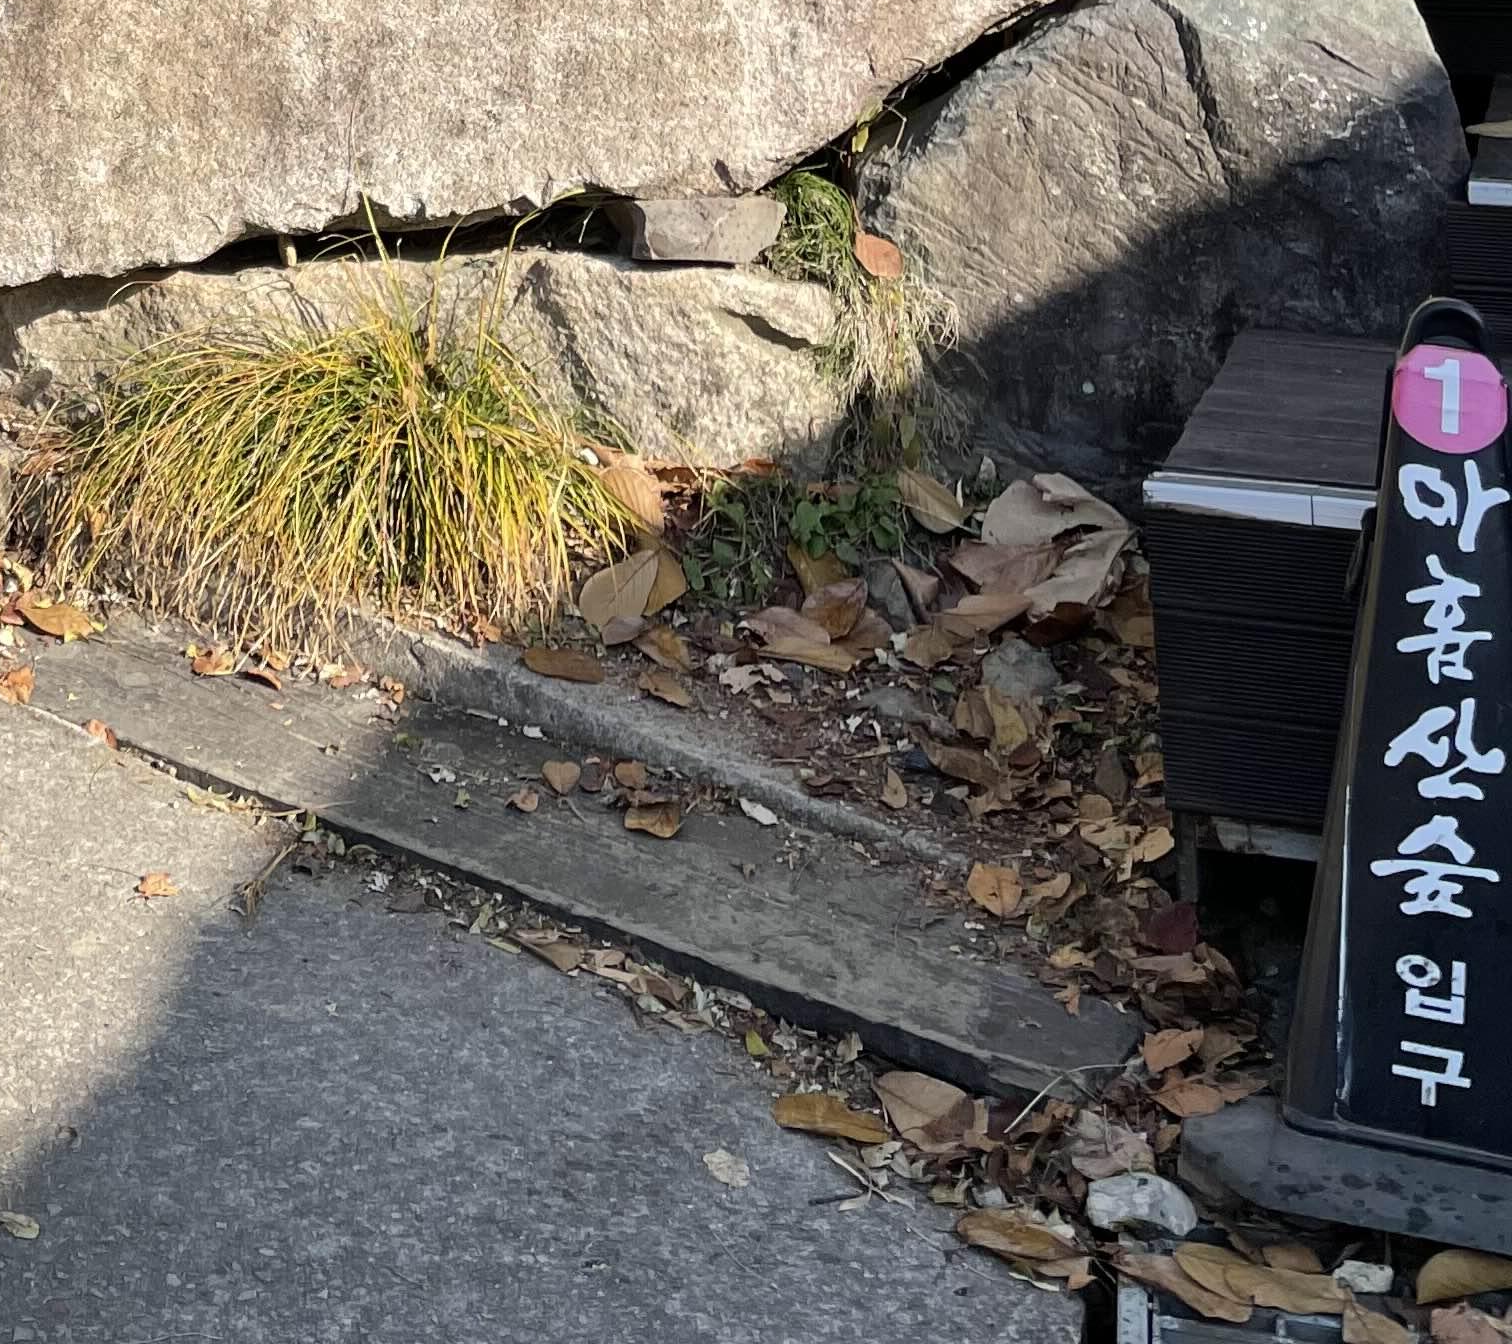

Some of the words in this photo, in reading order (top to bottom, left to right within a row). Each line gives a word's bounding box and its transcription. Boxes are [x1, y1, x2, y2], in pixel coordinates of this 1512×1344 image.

[1424, 358, 1462, 434] 1
[1369, 459, 1511, 919] 아홉산숲
[1391, 954, 1471, 1107] 입구
